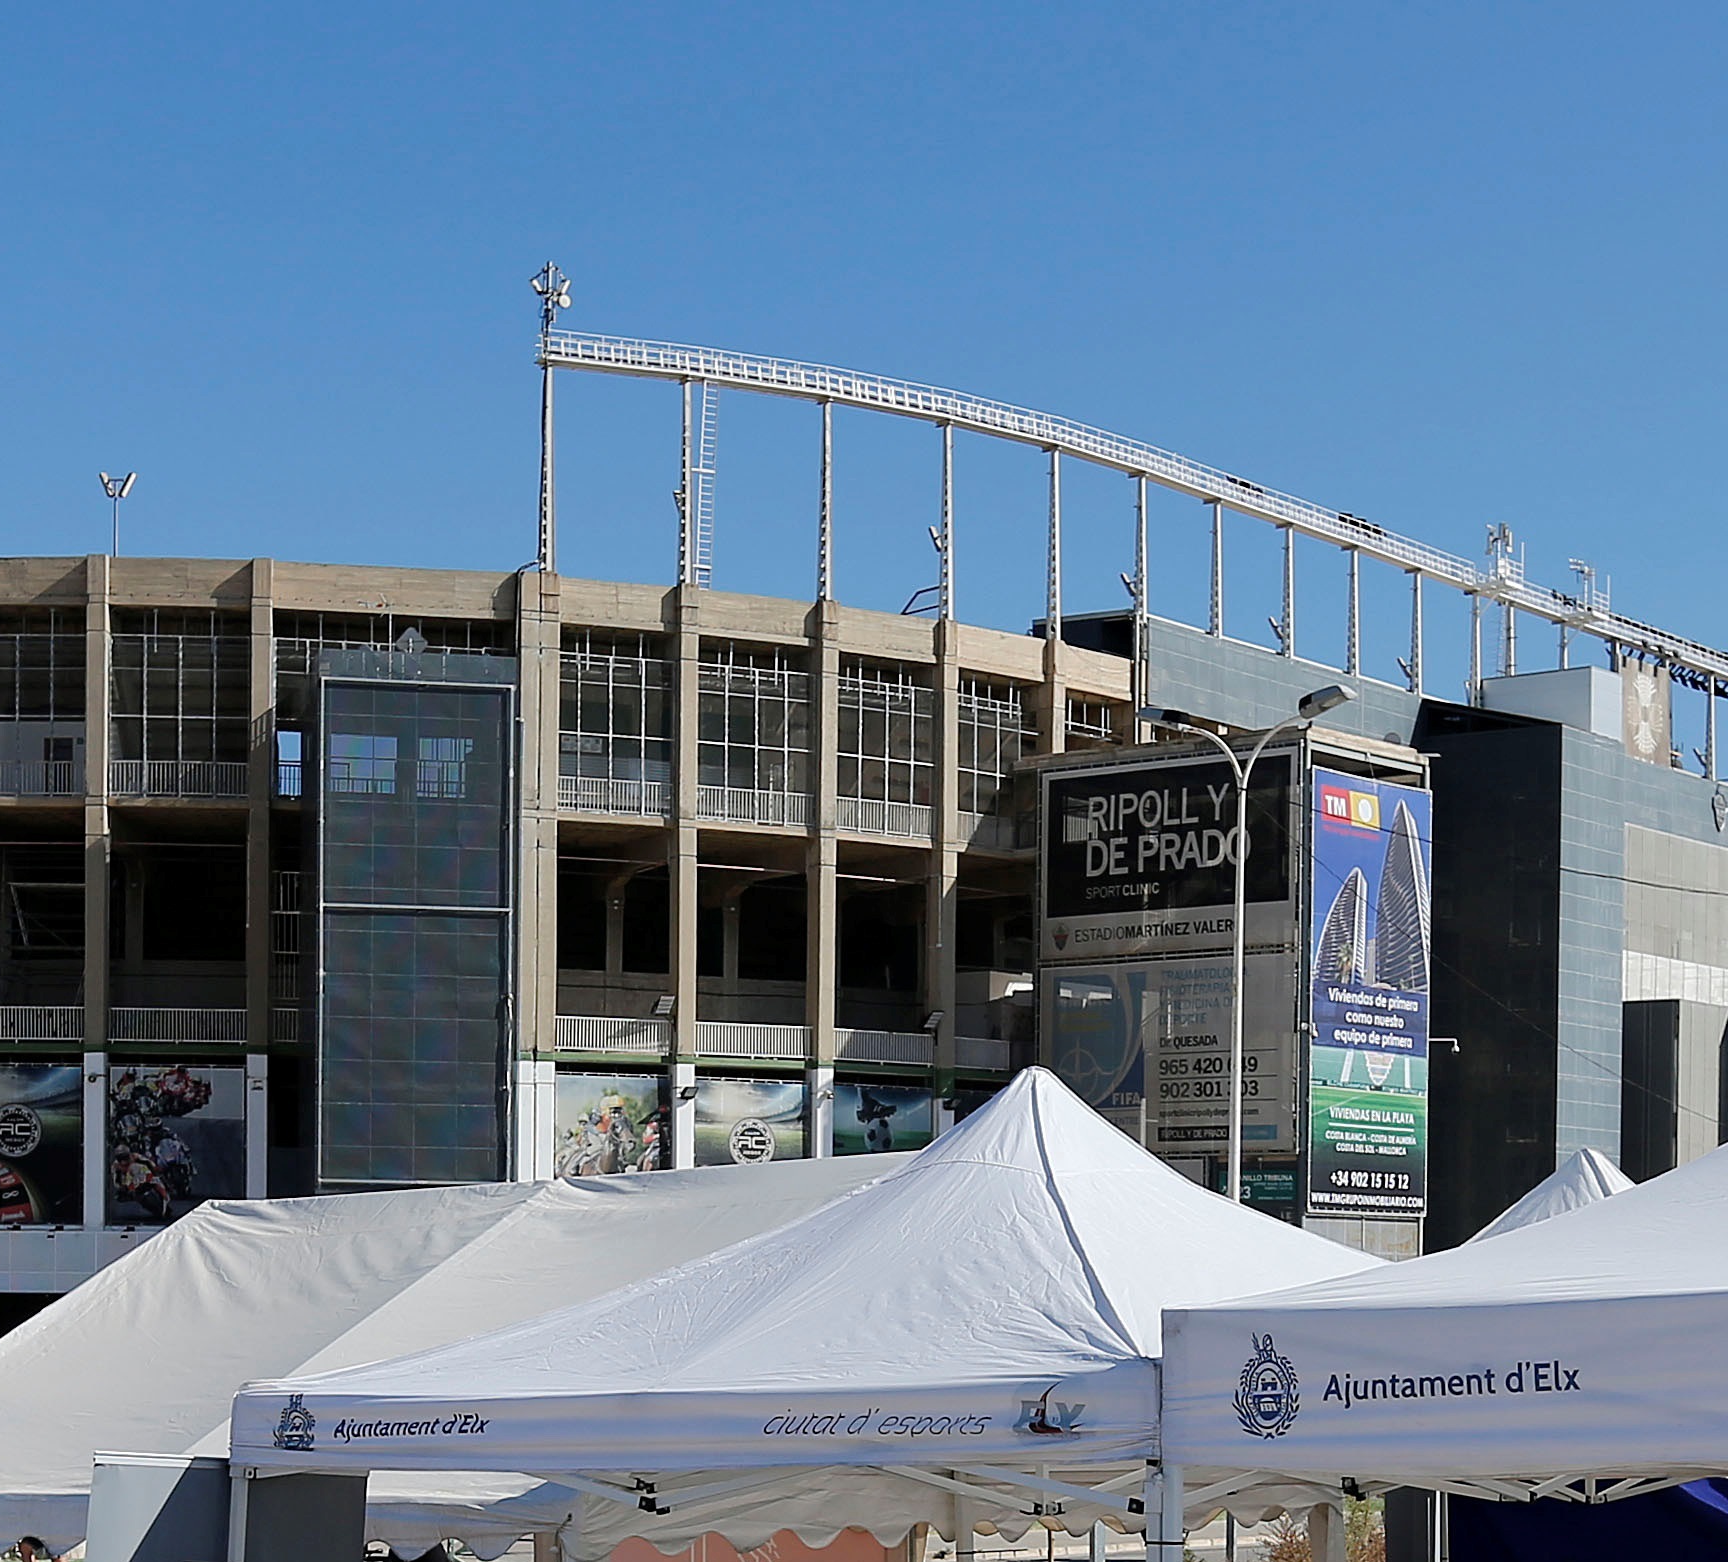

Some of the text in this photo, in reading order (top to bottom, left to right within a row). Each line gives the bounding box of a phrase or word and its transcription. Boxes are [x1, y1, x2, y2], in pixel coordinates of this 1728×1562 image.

[1088, 782, 1230, 832] RIPOLL Y
[1324, 794, 1347, 817] TM
[1086, 826, 1252, 878] DE PRADO
[1193, 918, 1235, 934] VALER
[1328, 987, 1419, 1012] Viviendas de primera
[1345, 1011, 1405, 1029] como nuestro
[1173, 1034, 1218, 1049] QUESADA
[1333, 1028, 1413, 1049] equipo de primera
[1159, 1059, 1188, 1076] 965
[1192, 1057, 1223, 1074] 420
[1112, 1092, 1141, 1105] FIFA
[1159, 1082, 1190, 1099] 902
[1193, 1081, 1223, 1098] 301
[1328, 1106, 1415, 1124] VIVIENDAS EN LA PLAYA
[1330, 1170, 1409, 1190] +34 902 15 15 12
[1323, 1370, 1498, 1409] Ajuntament
[333, 1417, 440, 1444] Ajuntament
[763, 1407, 846, 1436] ciutat
[877, 1412, 992, 1438] esports
